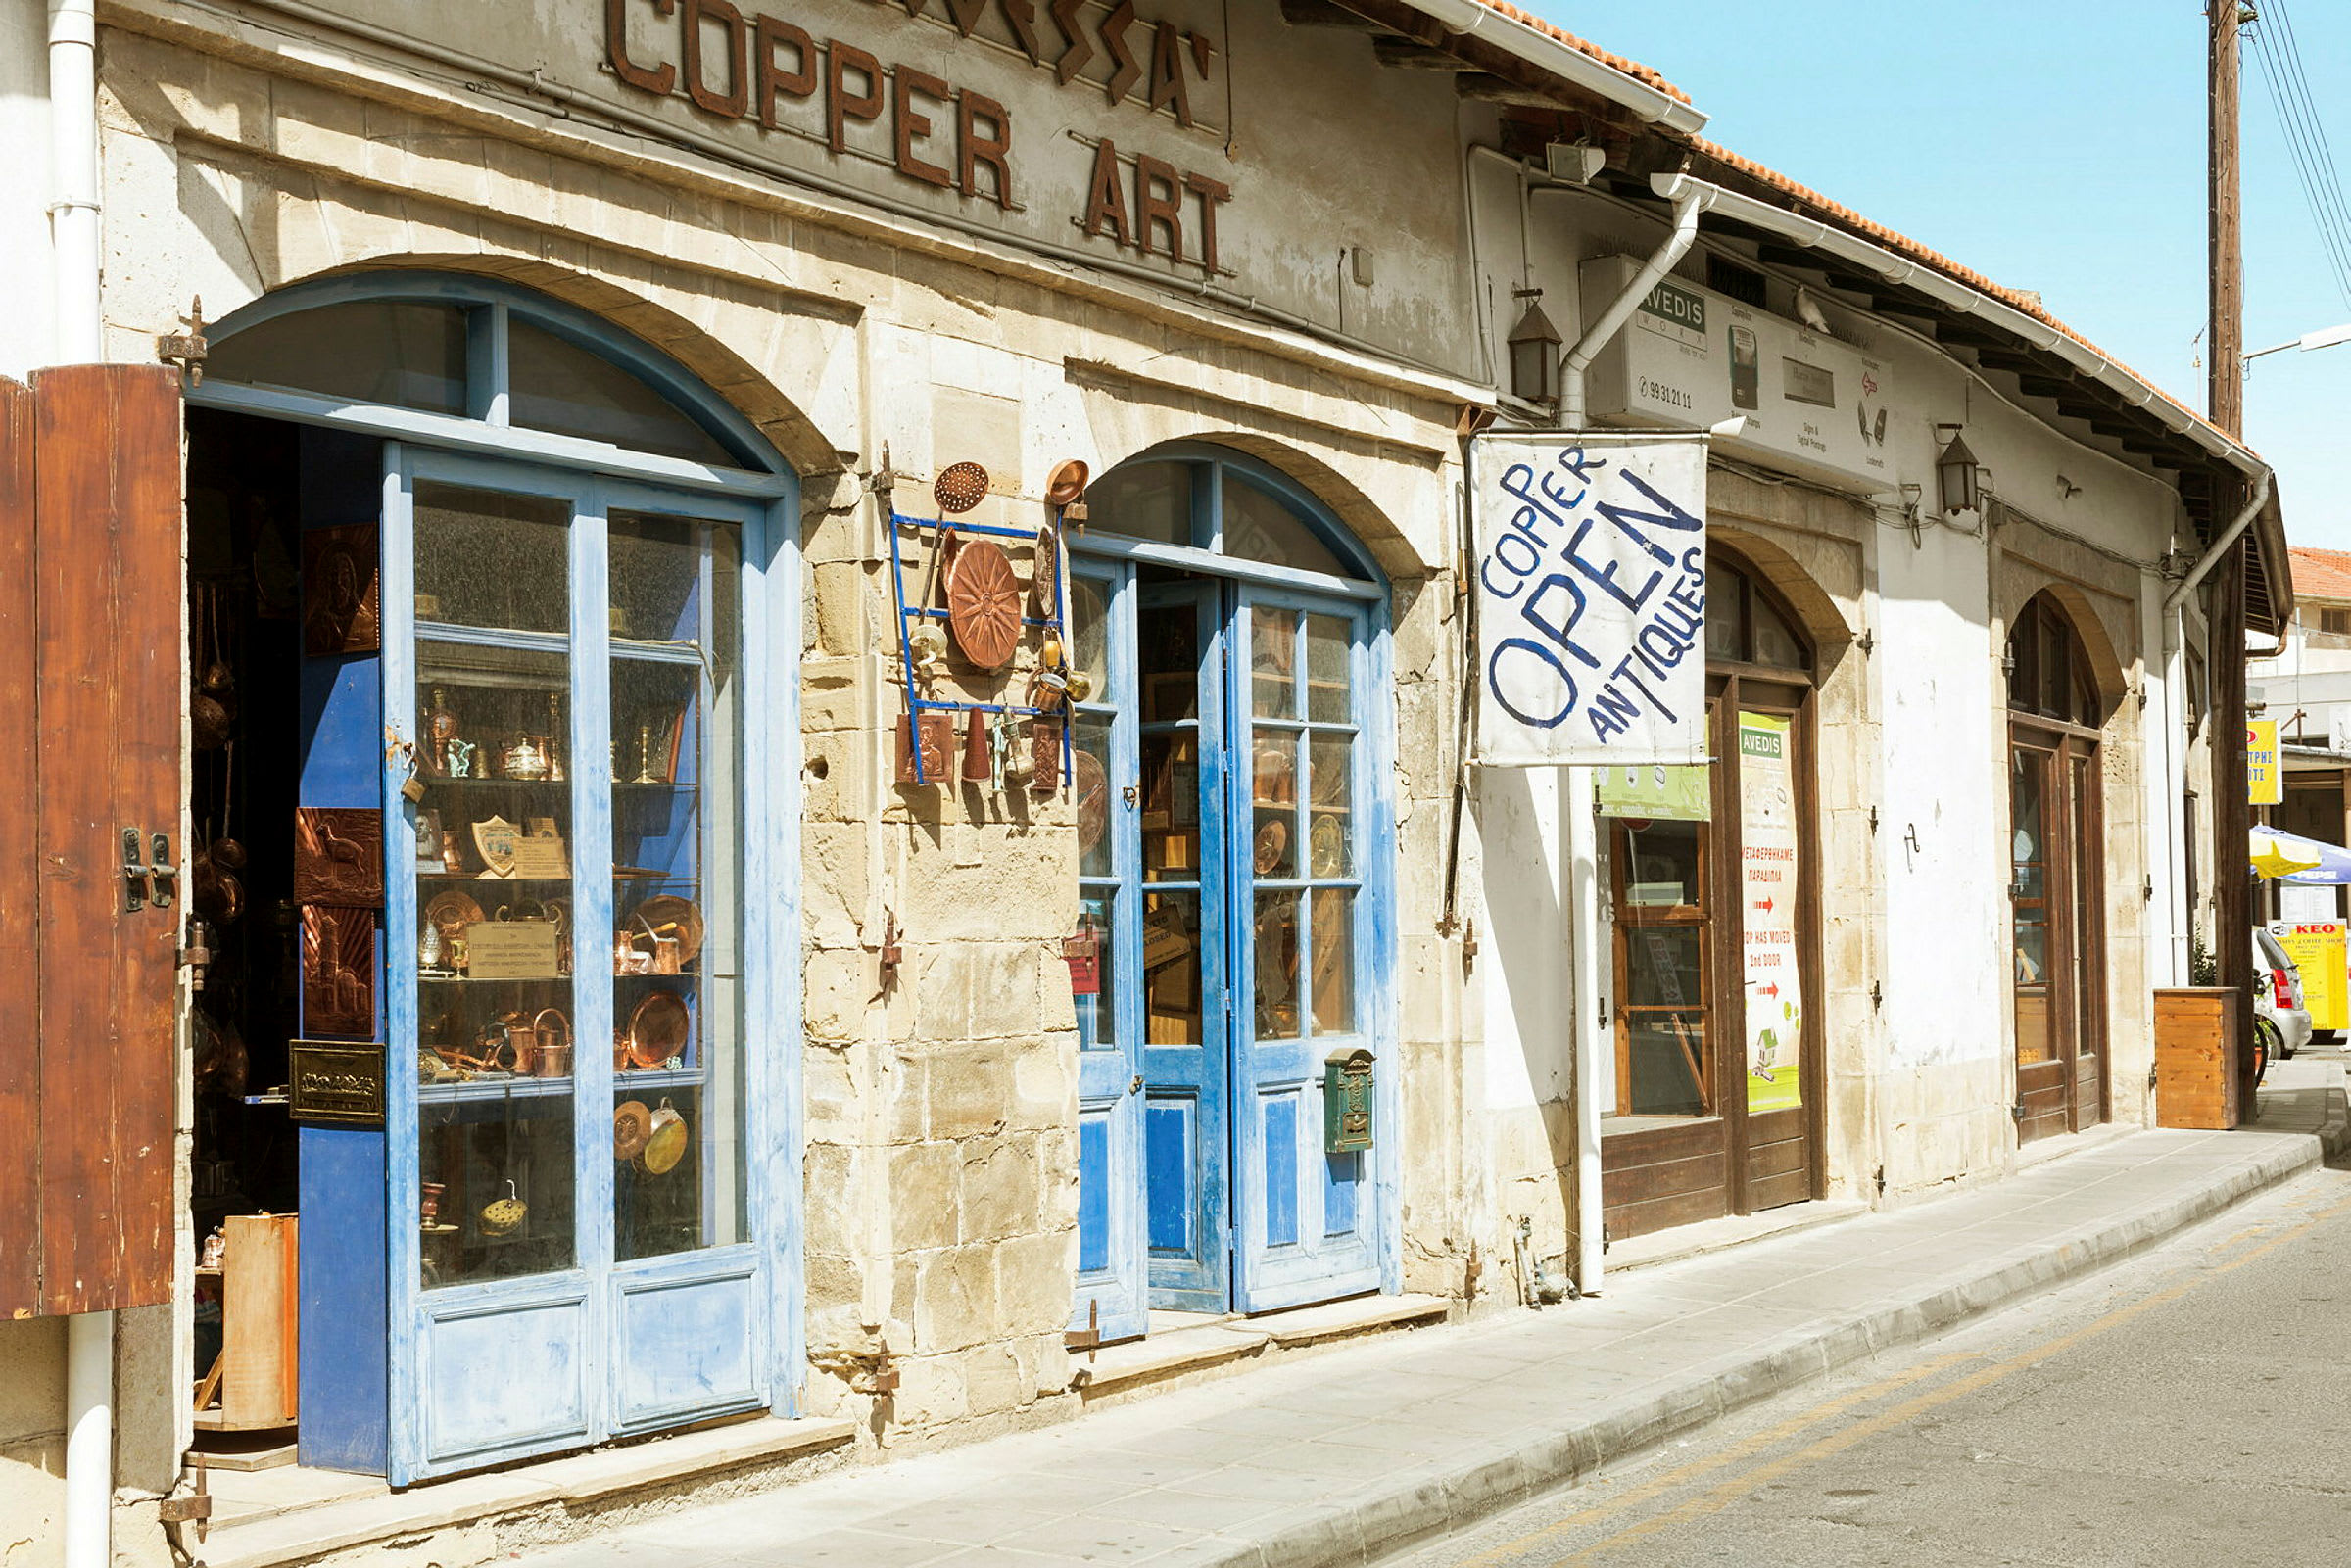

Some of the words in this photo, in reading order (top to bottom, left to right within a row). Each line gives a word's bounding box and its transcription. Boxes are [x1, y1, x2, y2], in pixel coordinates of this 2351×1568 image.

[608, 0, 1012, 211] COPPER
[1087, 137, 1231, 274] ART
[1650, 381, 1659, 400] 99
[1660, 385, 1671, 404] 31
[1671, 389, 1681, 406] 21
[1683, 392, 1692, 409] 11
[1481, 445, 1607, 599] COPPER
[1489, 468, 1703, 729] OPEN
[1587, 546, 1706, 744] ANTIQUES
[1744, 734, 1780, 754] AVEDIS
[1769, 931, 1791, 944] MOVED
[2296, 924, 2336, 934] KEO
[1750, 953, 1761, 967] 2nd
[1763, 953, 1781, 967] DOOR
